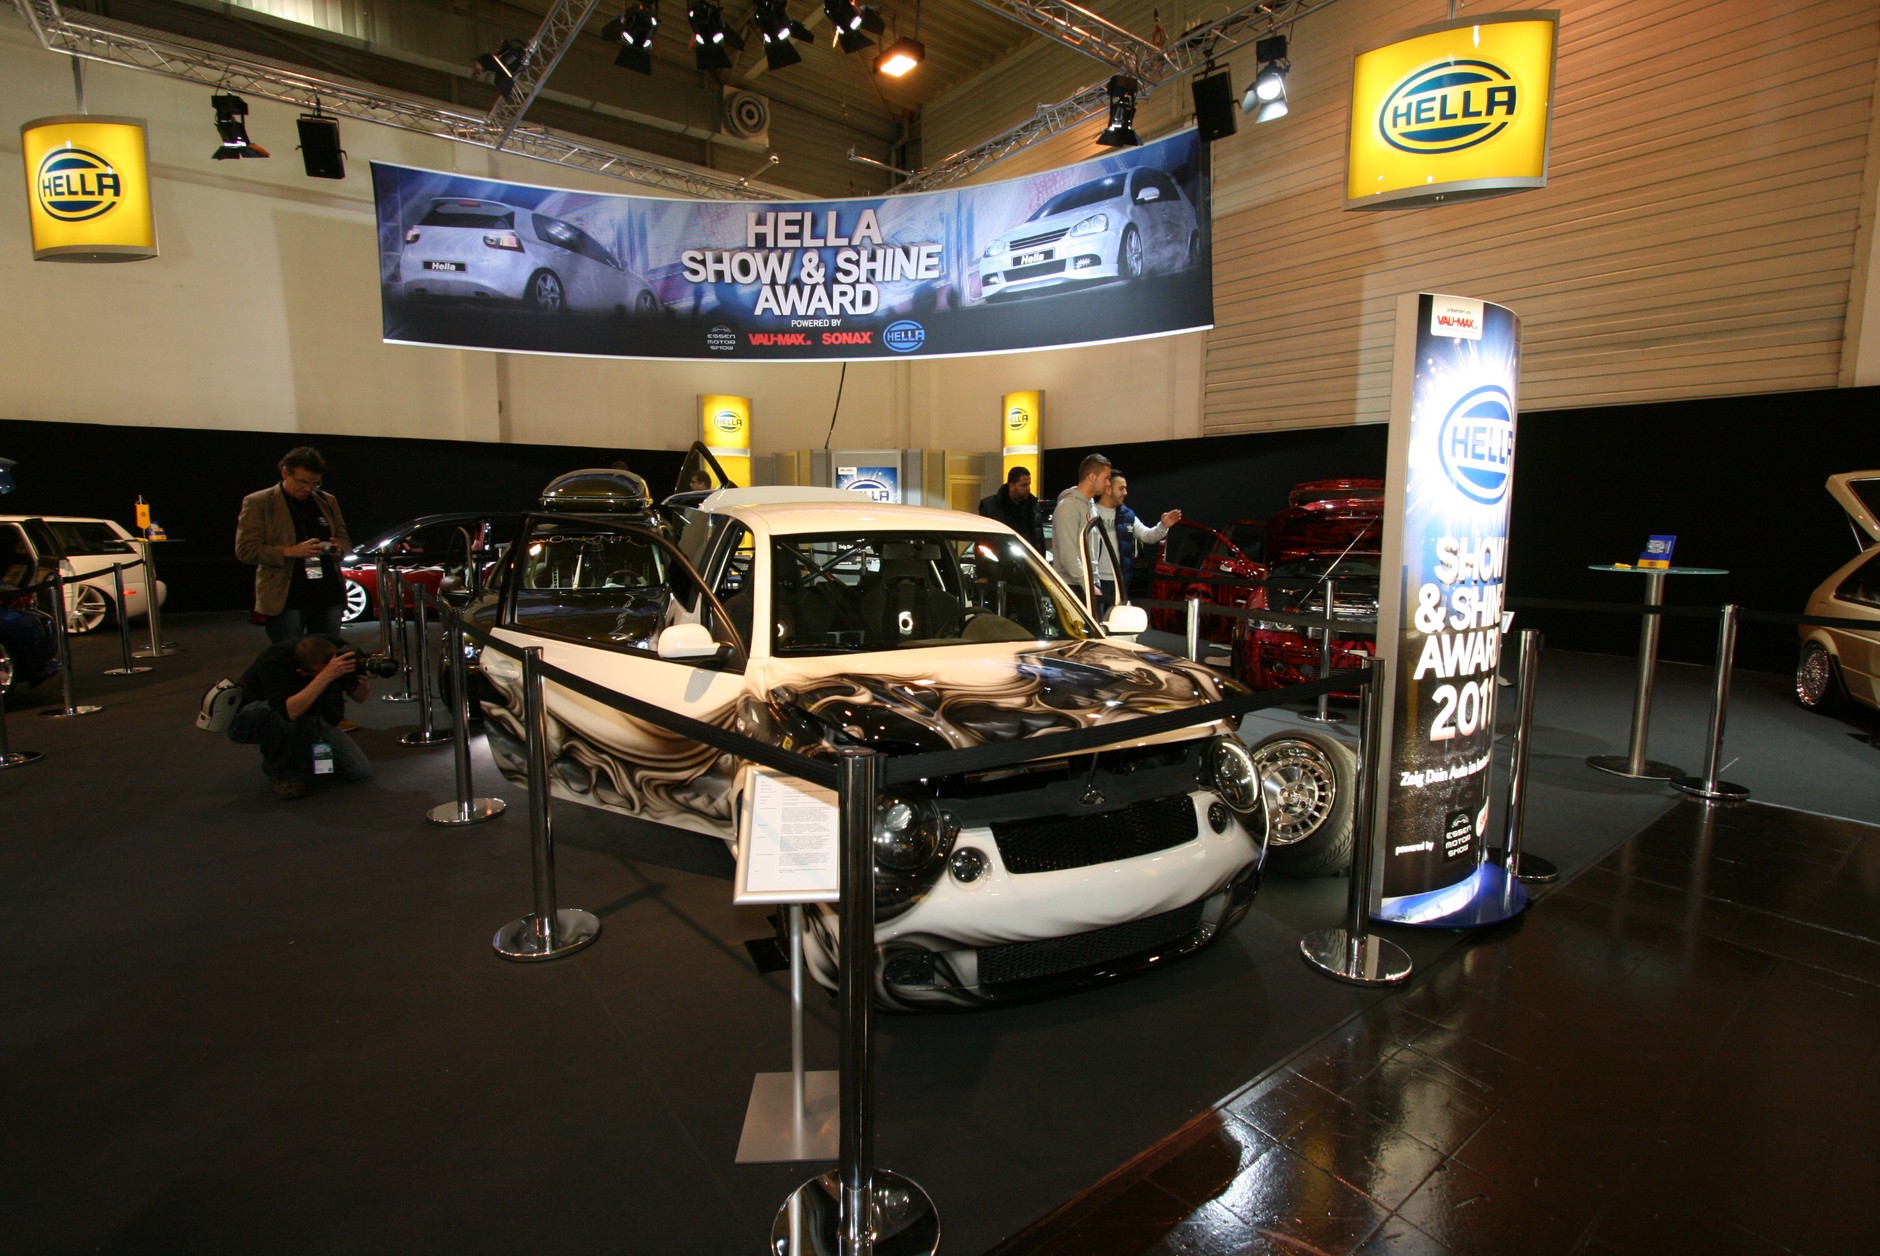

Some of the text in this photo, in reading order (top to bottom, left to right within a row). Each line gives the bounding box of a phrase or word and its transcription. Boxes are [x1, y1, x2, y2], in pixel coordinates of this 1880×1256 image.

[1392, 85, 1516, 129] HELLA
[42, 173, 121, 197] HELLA
[747, 208, 883, 248] HELLA
[431, 261, 456, 271] Hella
[681, 244, 943, 285] SHOW & SHINE
[1021, 252, 1045, 265] Hella
[754, 283, 879, 316] AWARD
[791, 318, 842, 328] POWERED BY
[822, 331, 872, 345] SONAX
[887, 329, 925, 341] HELLA
[716, 418, 742, 426] HELLA
[1414, 583, 1446, 634] &
[1413, 627, 1499, 680] AWARD
[1430, 675, 1494, 742] 2011
[1400, 770, 1424, 787] Zeig
[1425, 768, 1448, 783] Dein
[1449, 764, 1468, 780] Auto
[1446, 824, 1472, 839] ESSEN
[1395, 840, 1435, 856] powered by
[1445, 834, 1472, 850] MOTOR
[1447, 844, 1469, 858] SHOW
